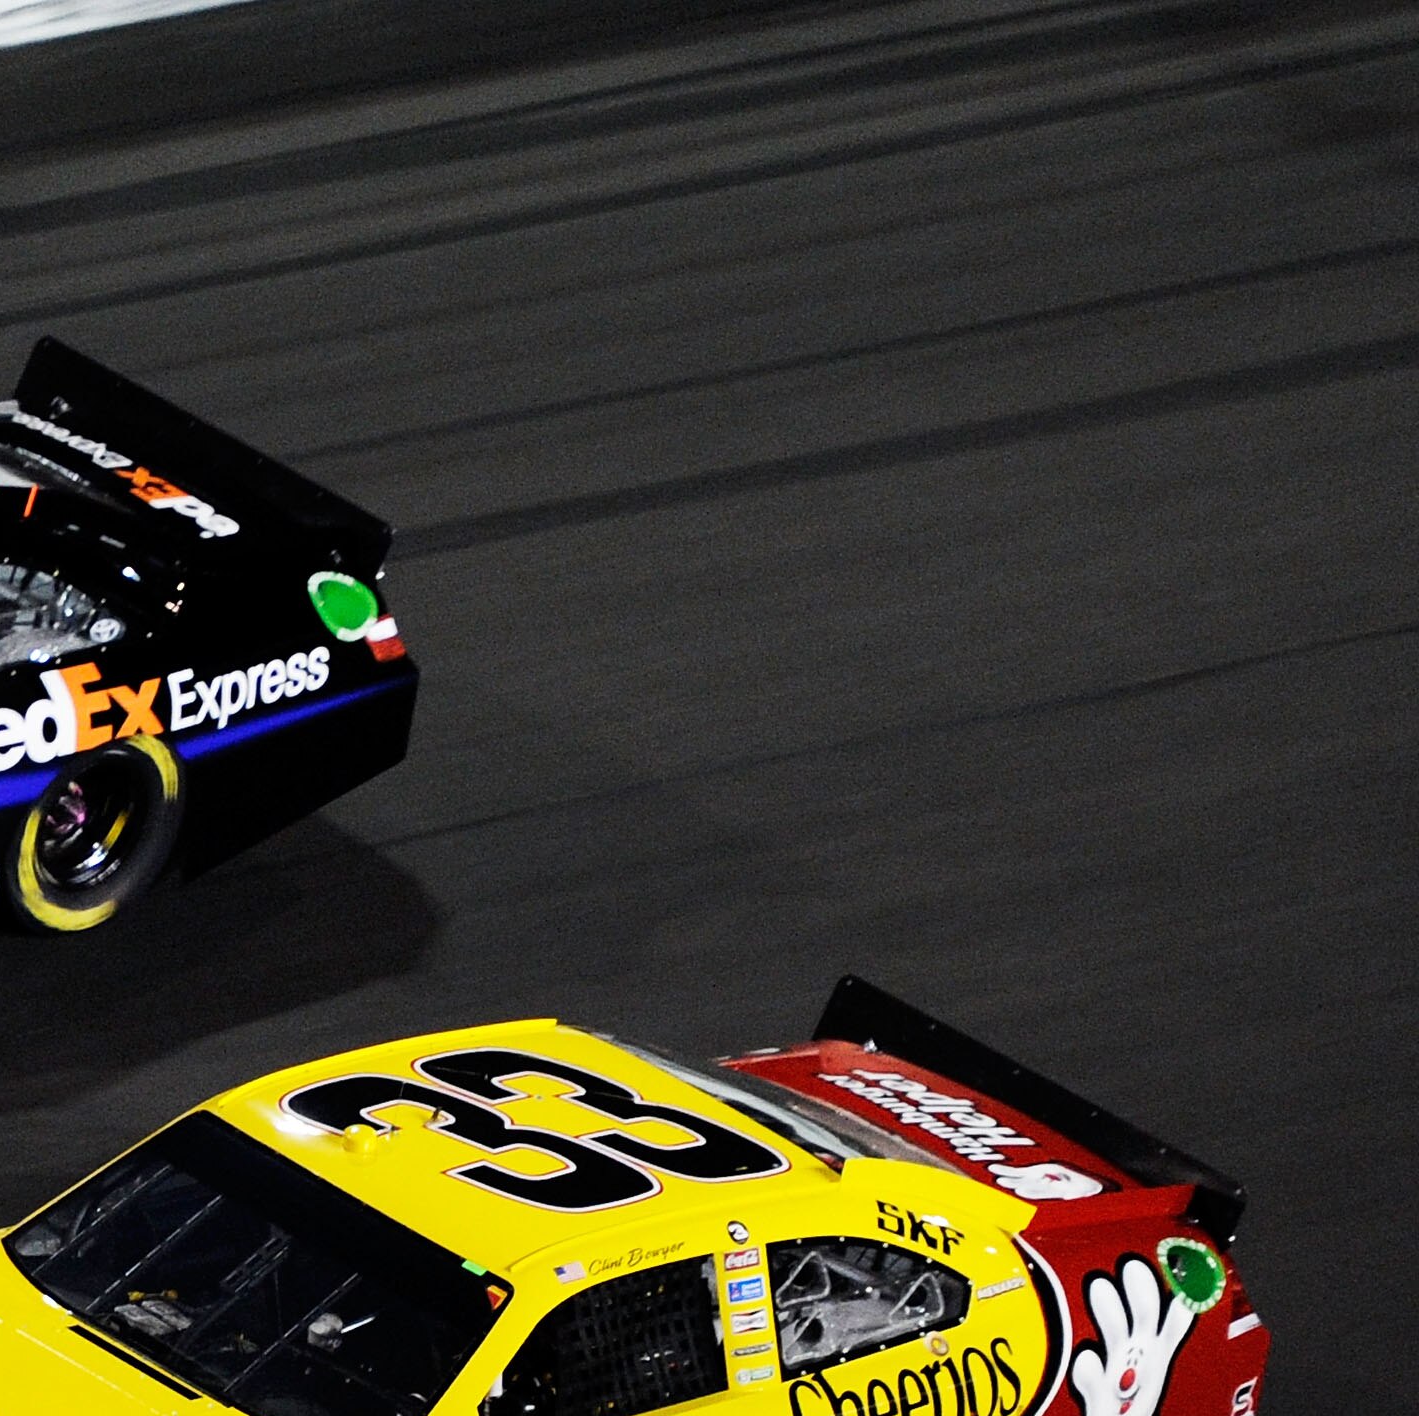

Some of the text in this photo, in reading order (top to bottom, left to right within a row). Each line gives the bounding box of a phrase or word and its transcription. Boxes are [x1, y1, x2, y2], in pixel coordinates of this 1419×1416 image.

[167, 646, 330, 733] Express
[281, 1047, 791, 1214] 33
[818, 1072, 1005, 1161] Hamburger
[852, 1069, 1036, 1146] Helper
[588, 1241, 685, 1276] Clint Bowyer
[876, 1200, 965, 1255] SKF
